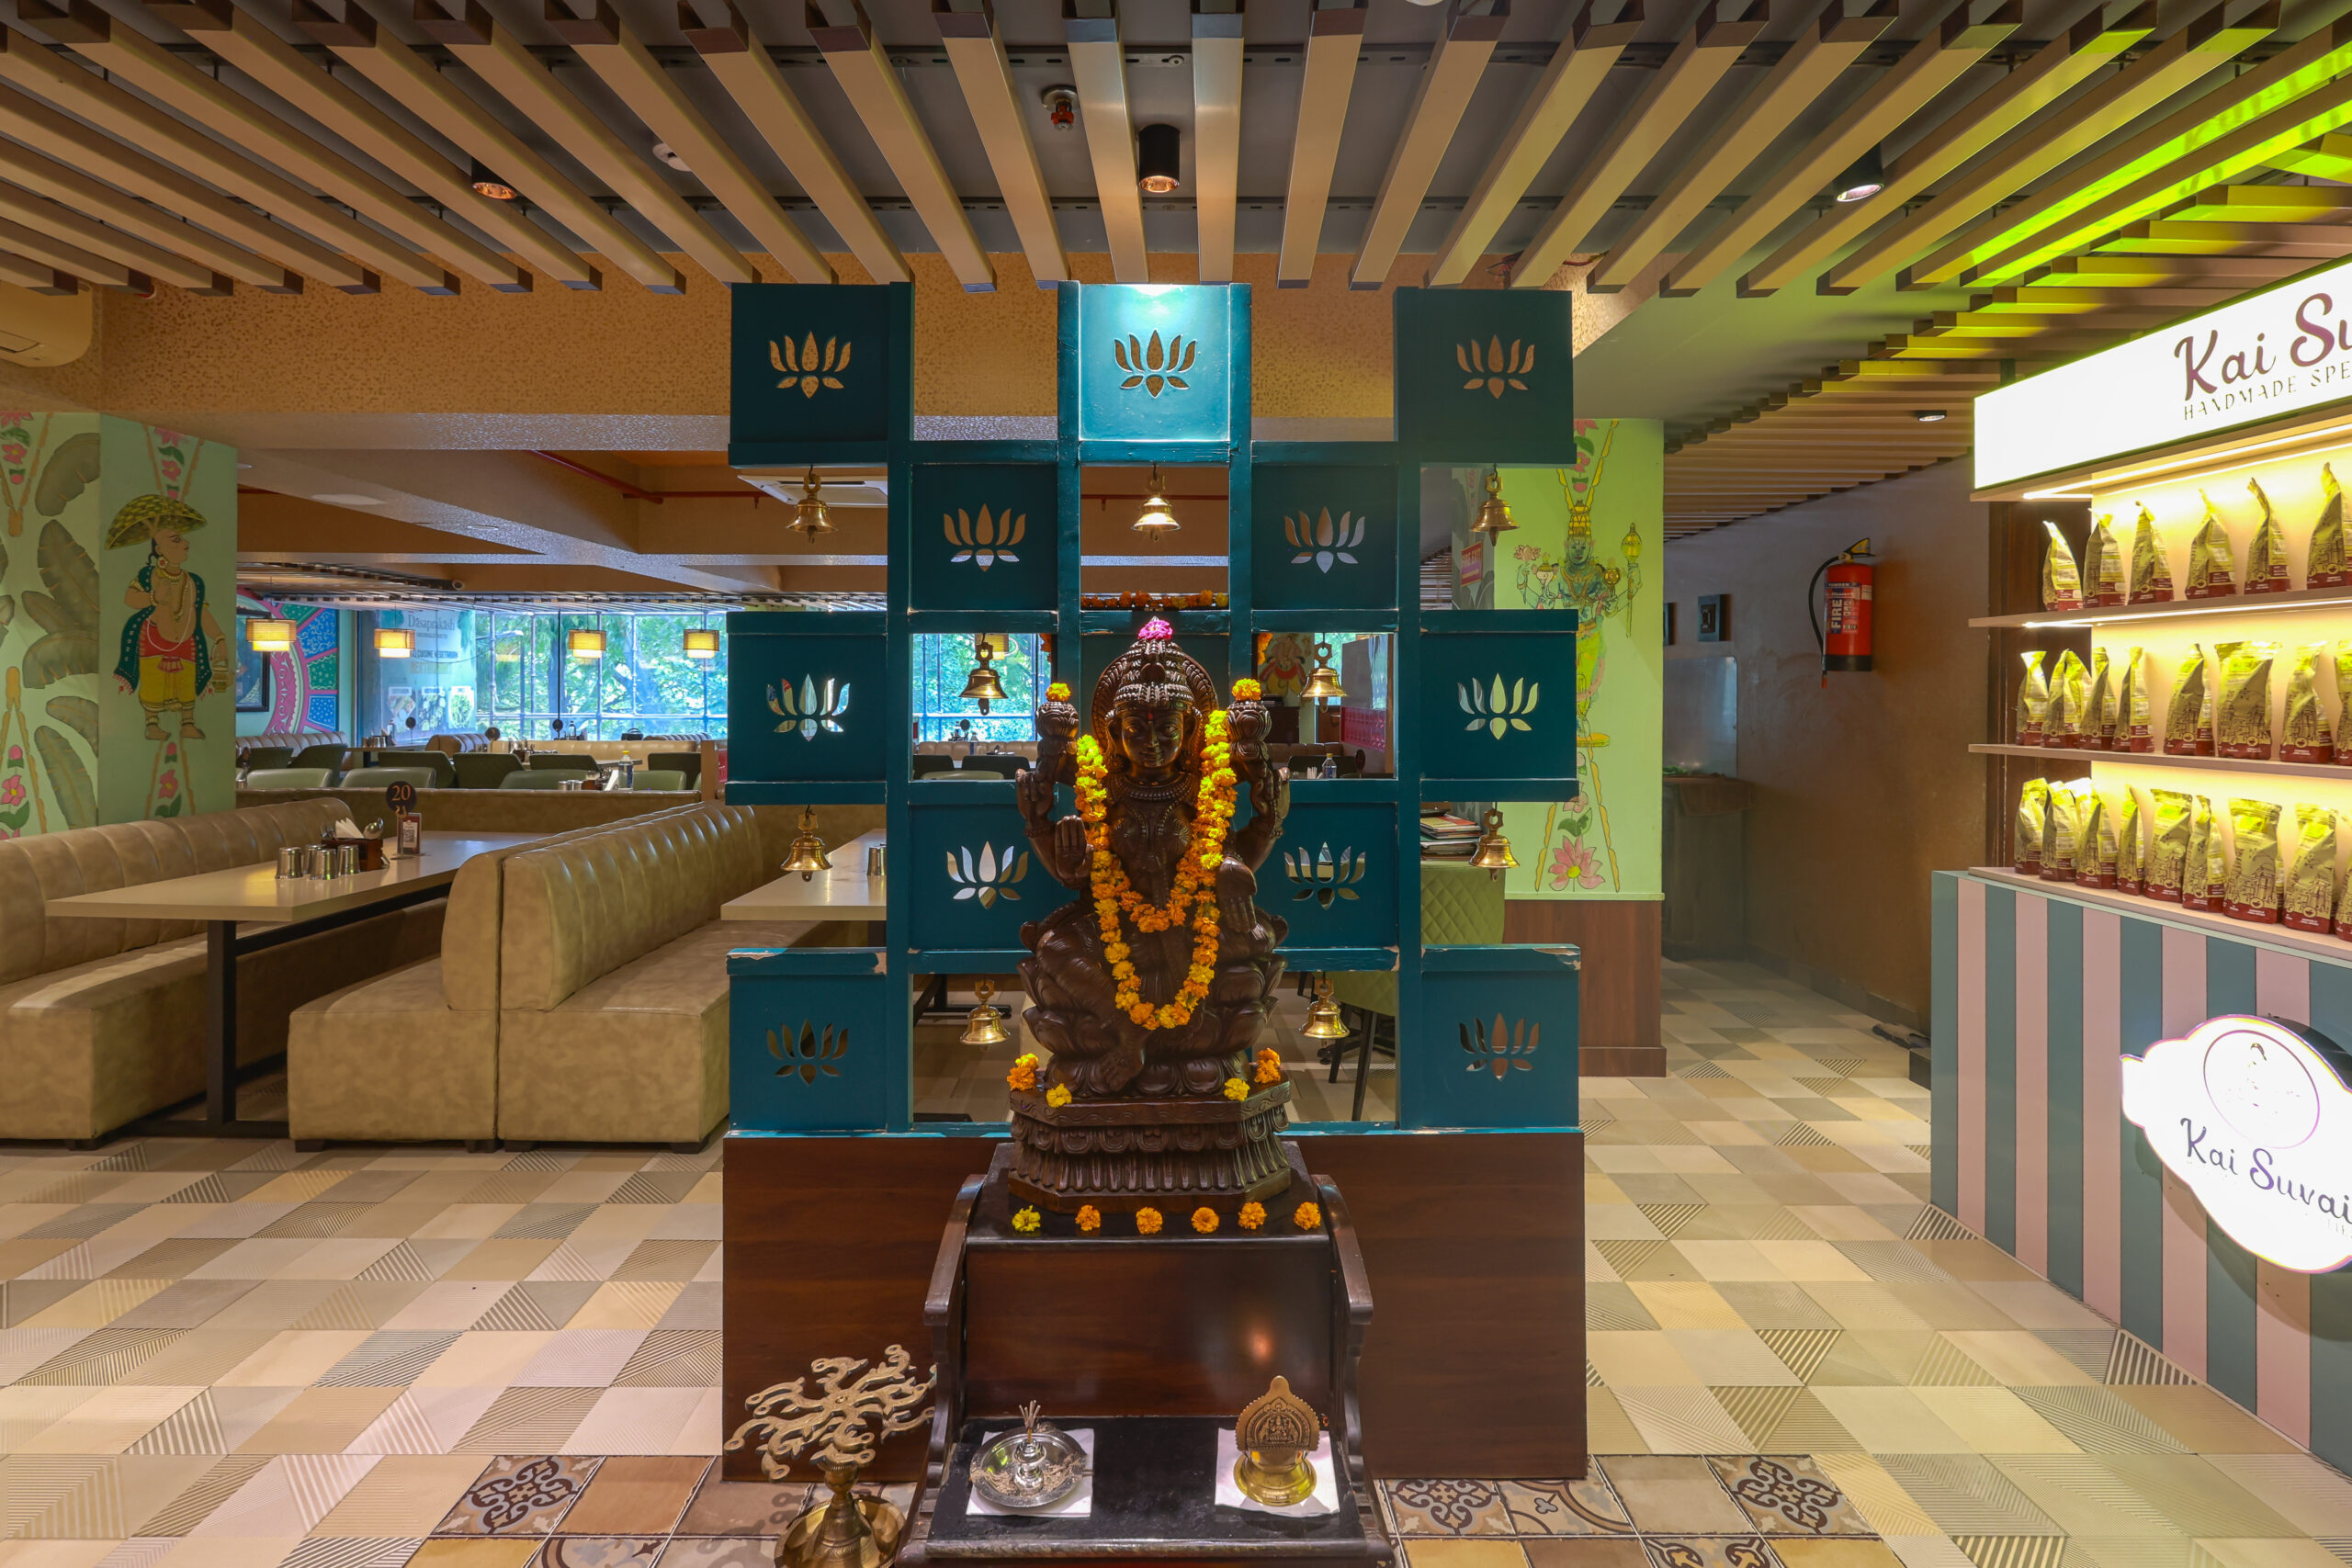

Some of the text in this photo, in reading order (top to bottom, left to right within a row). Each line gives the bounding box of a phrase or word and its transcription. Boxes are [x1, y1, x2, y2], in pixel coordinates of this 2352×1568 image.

[2174, 329, 2277, 401] Kai
[2184, 375, 2298, 421] HANDMADE
[1831, 599, 1843, 628] FIRE
[390, 784, 412, 802] 20
[2179, 1116, 2352, 1224] Kai Suvai
